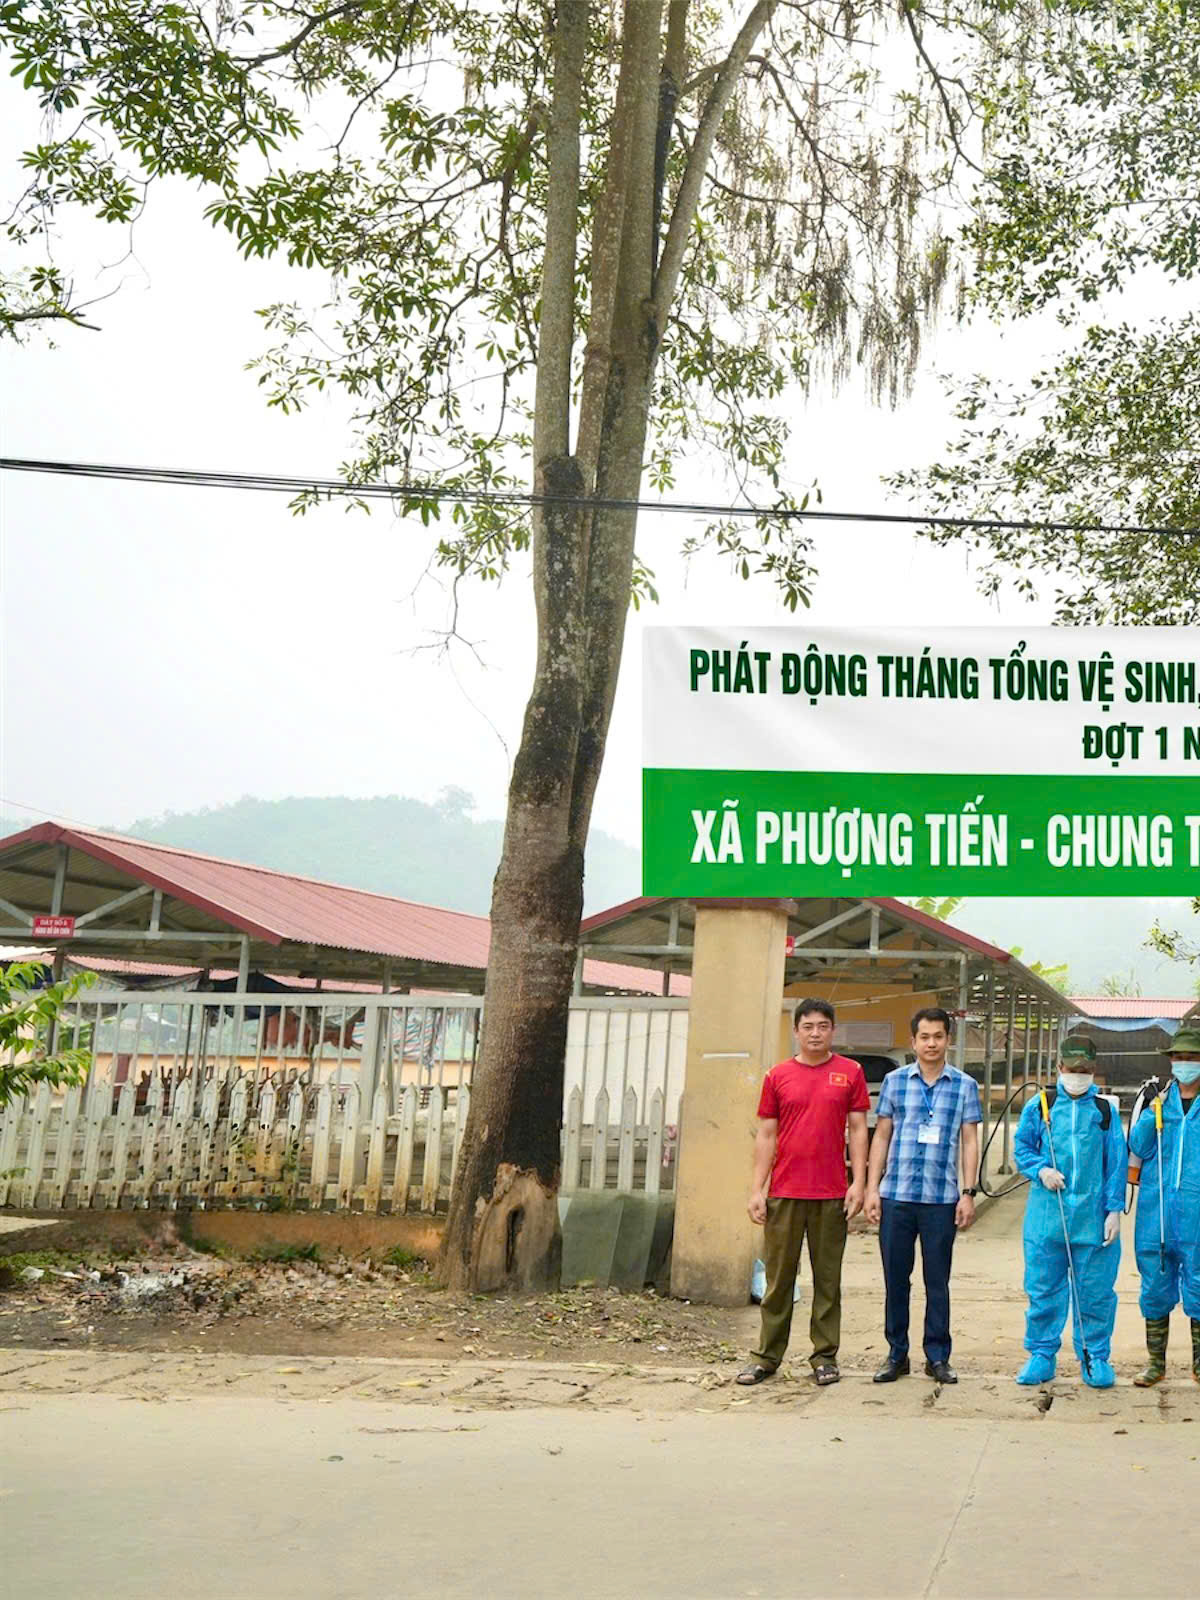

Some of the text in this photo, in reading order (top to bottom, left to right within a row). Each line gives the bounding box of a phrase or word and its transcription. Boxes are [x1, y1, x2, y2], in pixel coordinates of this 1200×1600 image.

[690, 641, 772, 694] PHÁT
[781, 644, 867, 705] ĐỘNG
[877, 647, 979, 699] THÁNG
[989, 640, 1068, 702] TỔNG
[1078, 651, 1114, 712] VỆ
[1082, 722, 1144, 767] ĐỢT
[1154, 726, 1168, 760] 1
[690, 800, 744, 864] XÃ
[757, 807, 913, 878] PHƯỢNG
[925, 795, 1008, 867] TIẾN
[1021, 838, 1034, 850] -
[1048, 814, 1173, 868] CHUNG
